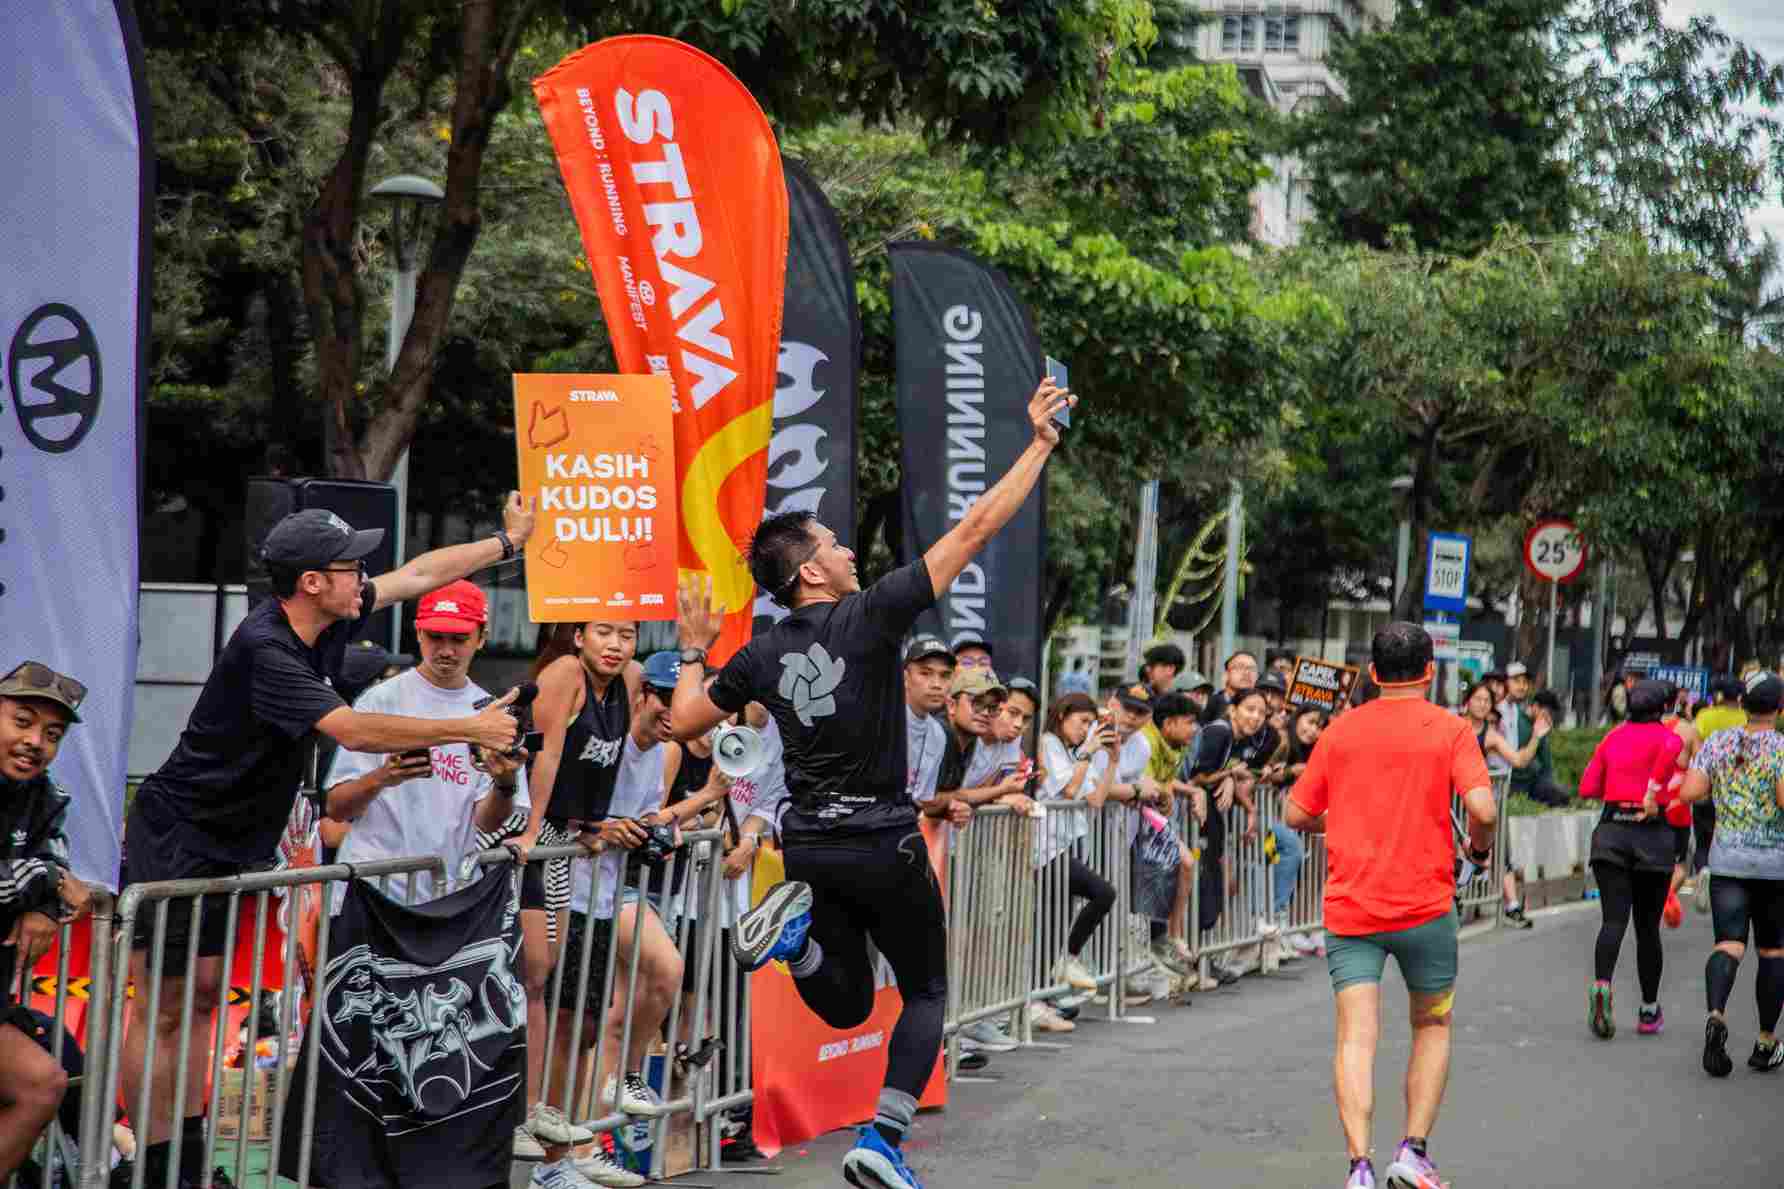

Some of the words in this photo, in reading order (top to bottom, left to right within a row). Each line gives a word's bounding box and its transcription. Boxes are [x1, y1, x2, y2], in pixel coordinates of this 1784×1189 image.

[576, 87, 606, 150] BEYOND
[599, 163, 628, 236] RUNNING
[614, 86, 738, 411] STRAVA
[617, 255, 648, 331] MANIFEST
[568, 390, 619, 402] STRAVA
[546, 453, 649, 479] KASIH
[541, 484, 657, 511] KUDOS
[1537, 541, 1567, 565] 25
